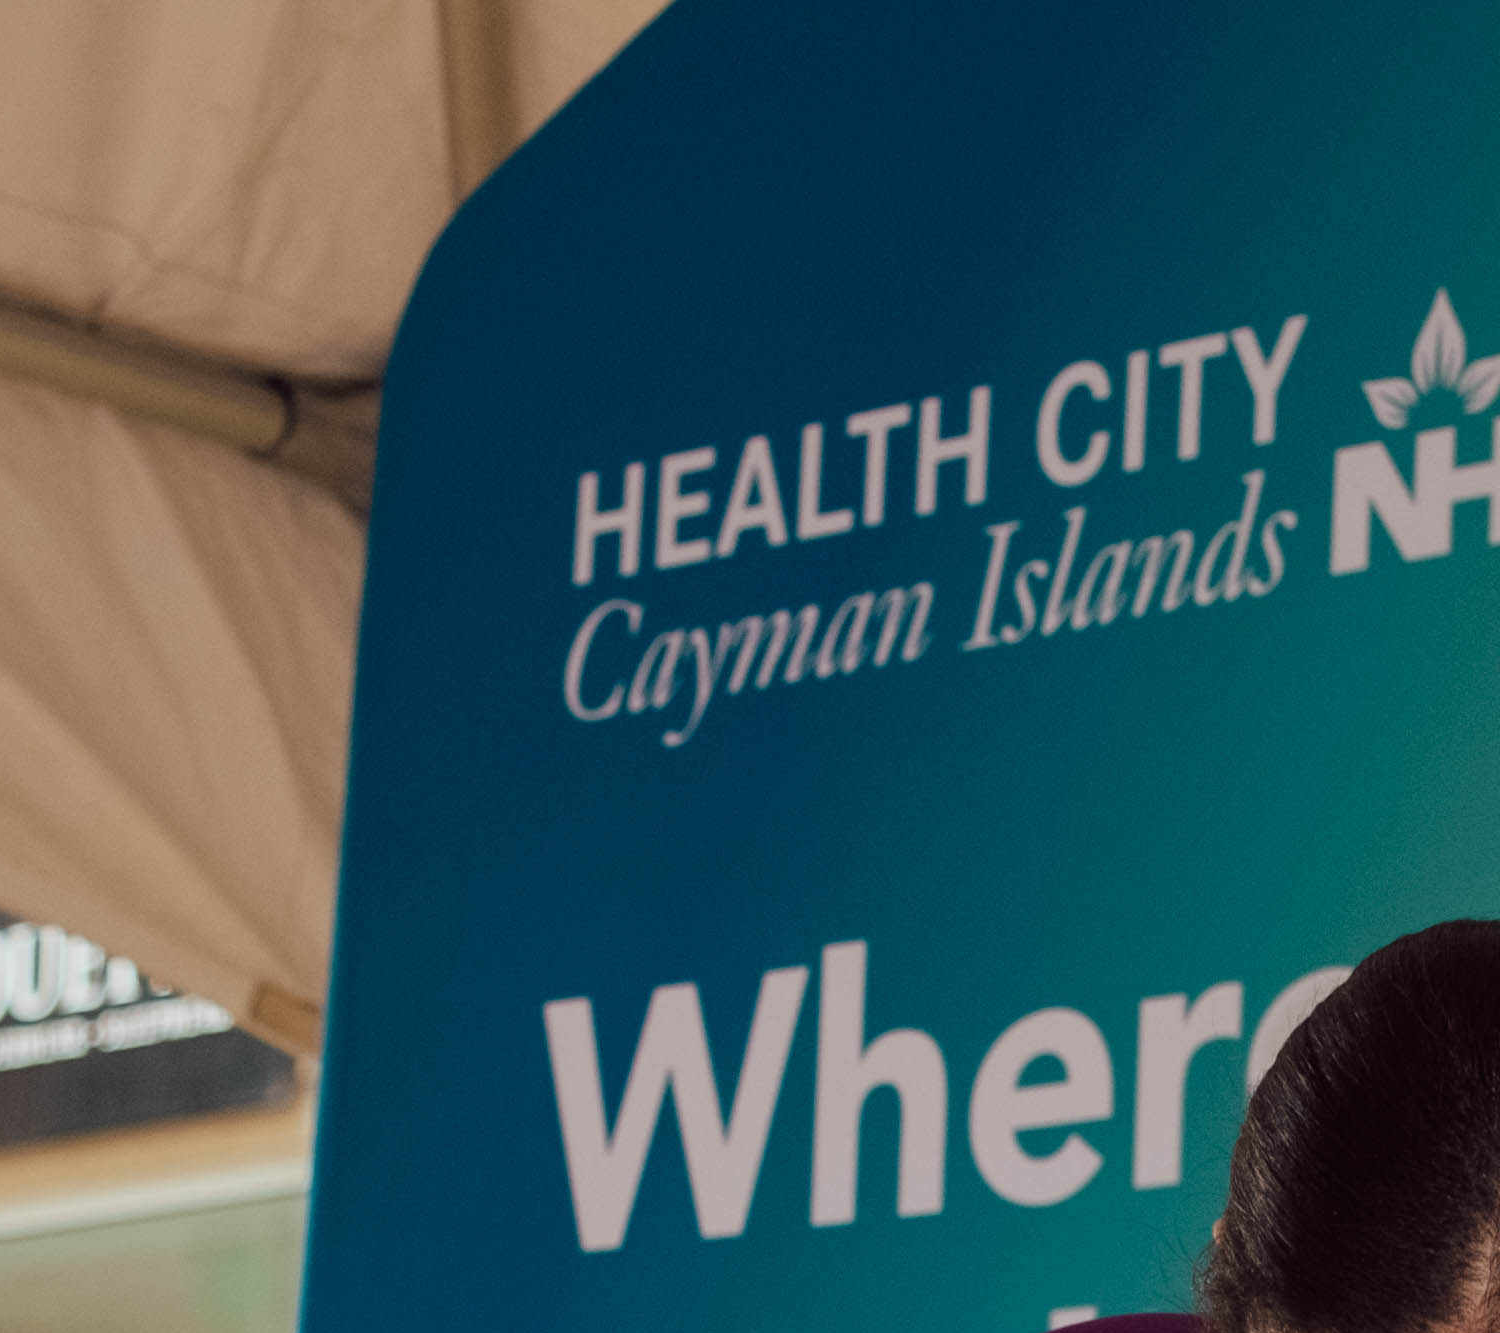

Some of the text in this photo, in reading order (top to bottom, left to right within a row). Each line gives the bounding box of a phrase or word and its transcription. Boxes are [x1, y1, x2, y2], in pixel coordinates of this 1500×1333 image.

[571, 314, 1307, 588] HEALTH CITY
[562, 470, 1301, 749] Cayman Islands
